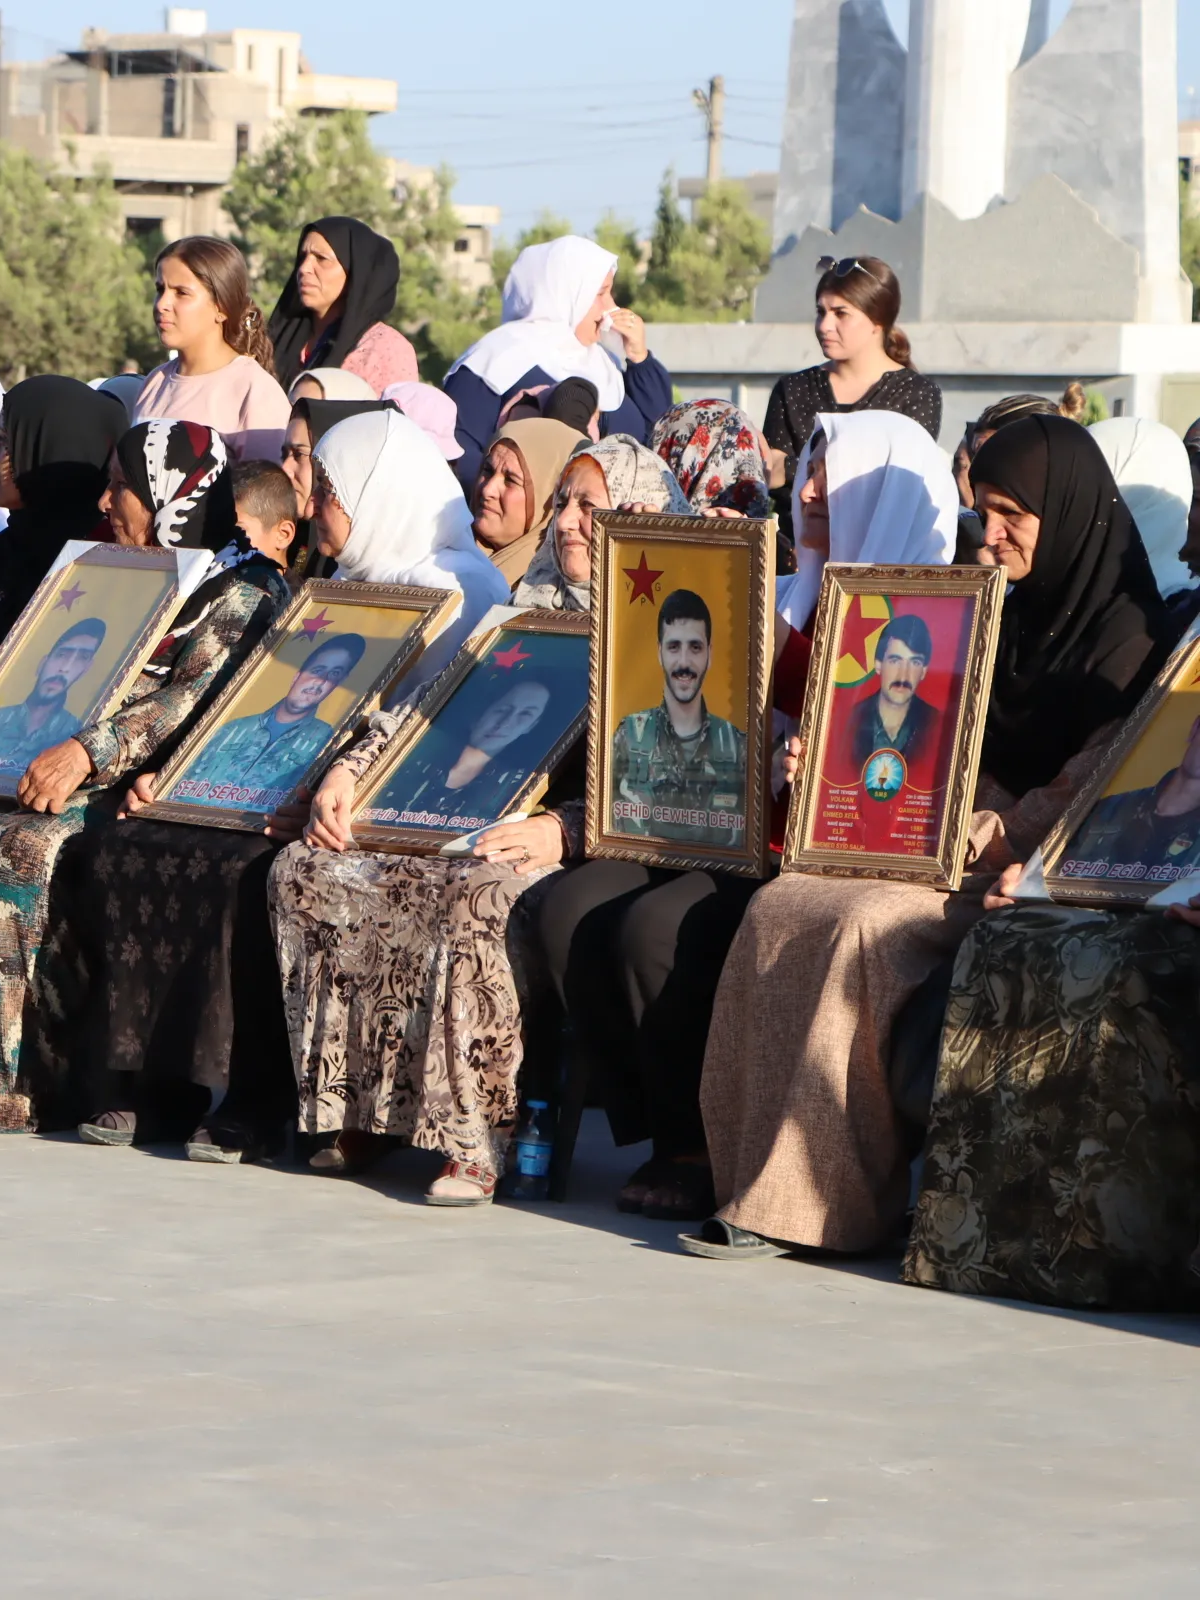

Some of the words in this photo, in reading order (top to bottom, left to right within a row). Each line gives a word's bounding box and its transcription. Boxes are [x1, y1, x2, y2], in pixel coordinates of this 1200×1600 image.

[614, 801, 650, 821] ŞEHÎD
[653, 806, 707, 827] CEWHER
[1059, 858, 1109, 876] ŞEHÎD
